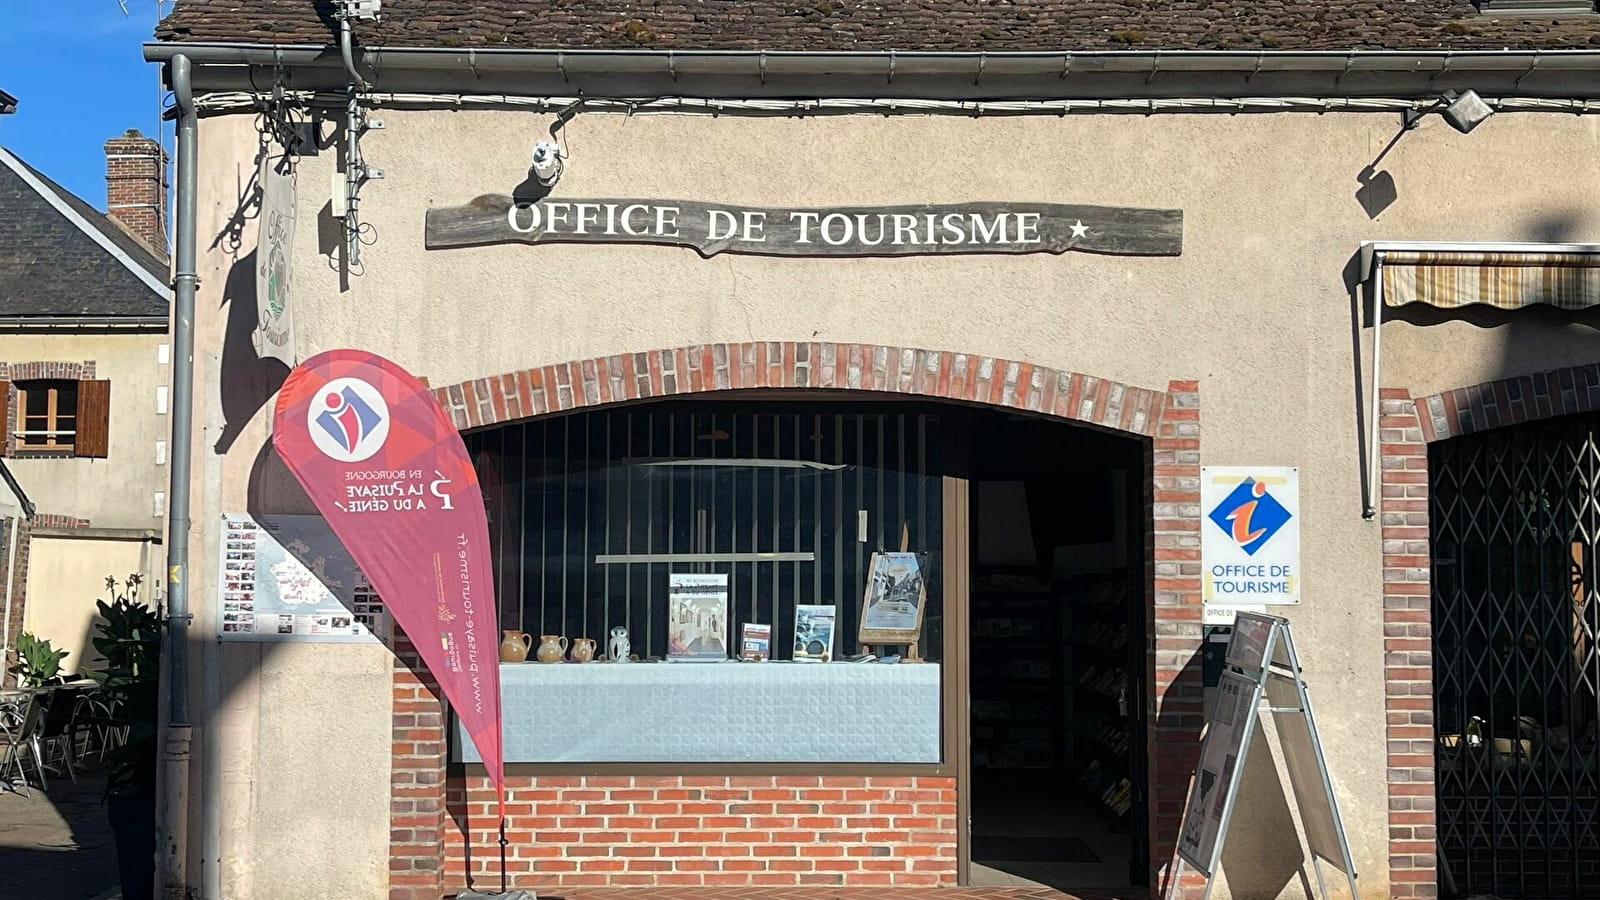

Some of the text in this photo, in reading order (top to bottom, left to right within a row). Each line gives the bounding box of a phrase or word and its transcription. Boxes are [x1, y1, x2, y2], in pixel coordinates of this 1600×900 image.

[508, 202, 1041, 245] OFFICE DE TOURISME
[1212, 565, 1291, 578] OFFICE DE
[1213, 581, 1289, 594] TOURISME
[1207, 608, 1225, 617] OFFICE
